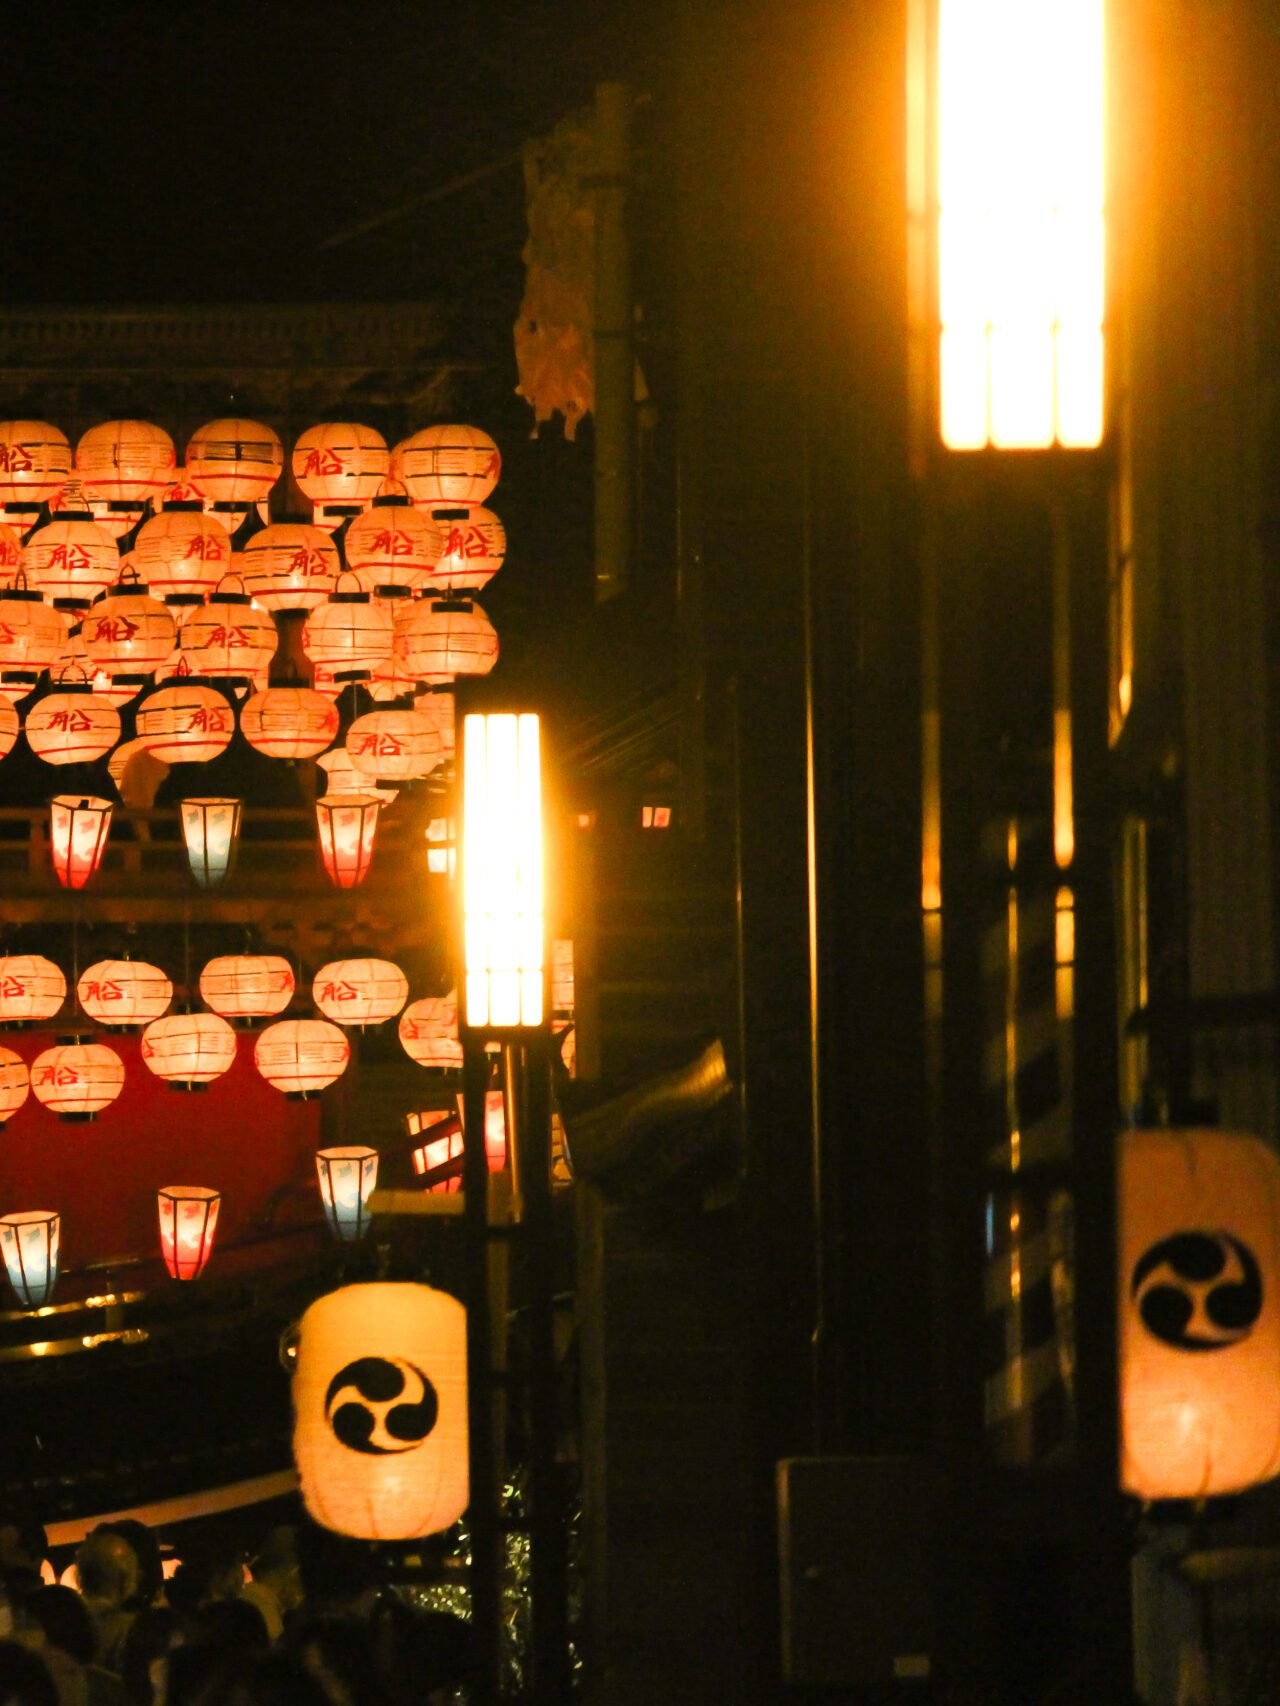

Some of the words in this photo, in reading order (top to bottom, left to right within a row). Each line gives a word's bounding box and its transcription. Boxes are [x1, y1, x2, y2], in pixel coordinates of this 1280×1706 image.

[304, 449, 345, 477] 船
[185, 535, 223, 561] 船
[371, 529, 415, 556] 船
[442, 527, 489, 560] 船
[48, 543, 93, 570] 船
[288, 549, 328, 576] 船
[95, 616, 140, 642] 船
[204, 627, 250, 648] 船
[46, 710, 92, 733] 船
[188, 707, 226, 732] 船
[359, 734, 404, 757] 船
[85, 981, 124, 1001] 船
[321, 981, 358, 1002] 船
[40, 1067, 79, 1087] 船
